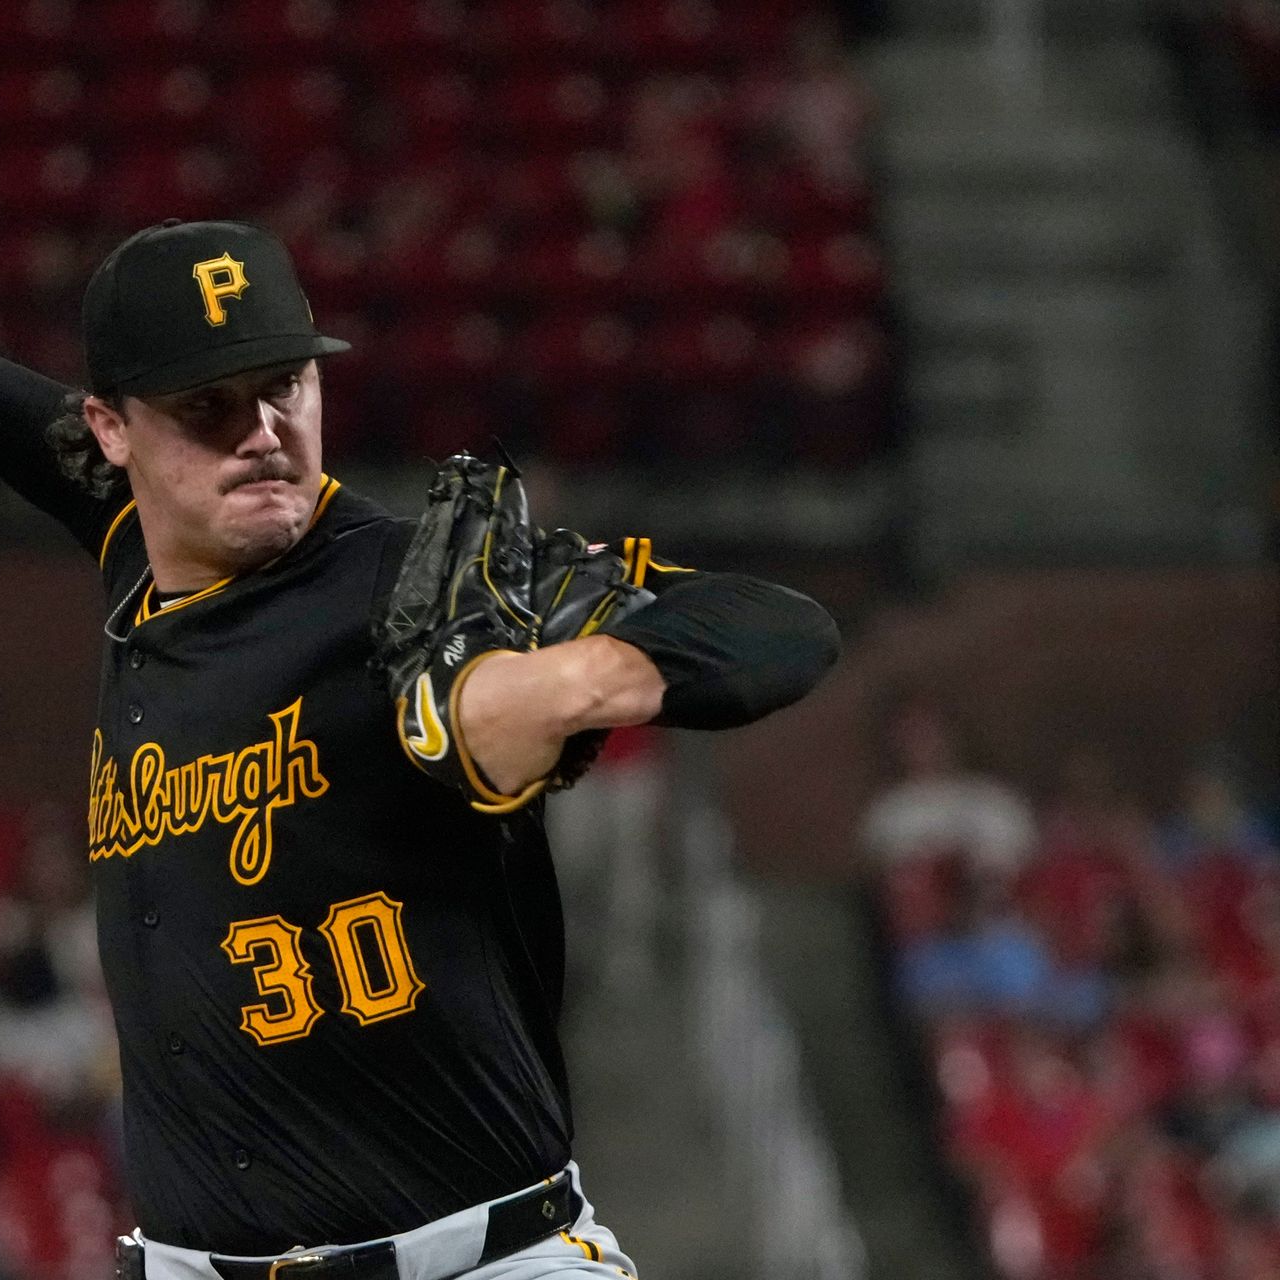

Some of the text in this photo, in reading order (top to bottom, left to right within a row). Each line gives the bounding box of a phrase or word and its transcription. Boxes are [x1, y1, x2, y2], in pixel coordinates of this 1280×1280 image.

[193, 252, 250, 327] P
[88, 696, 330, 886] ttsburgh
[220, 890, 426, 1046] 30
